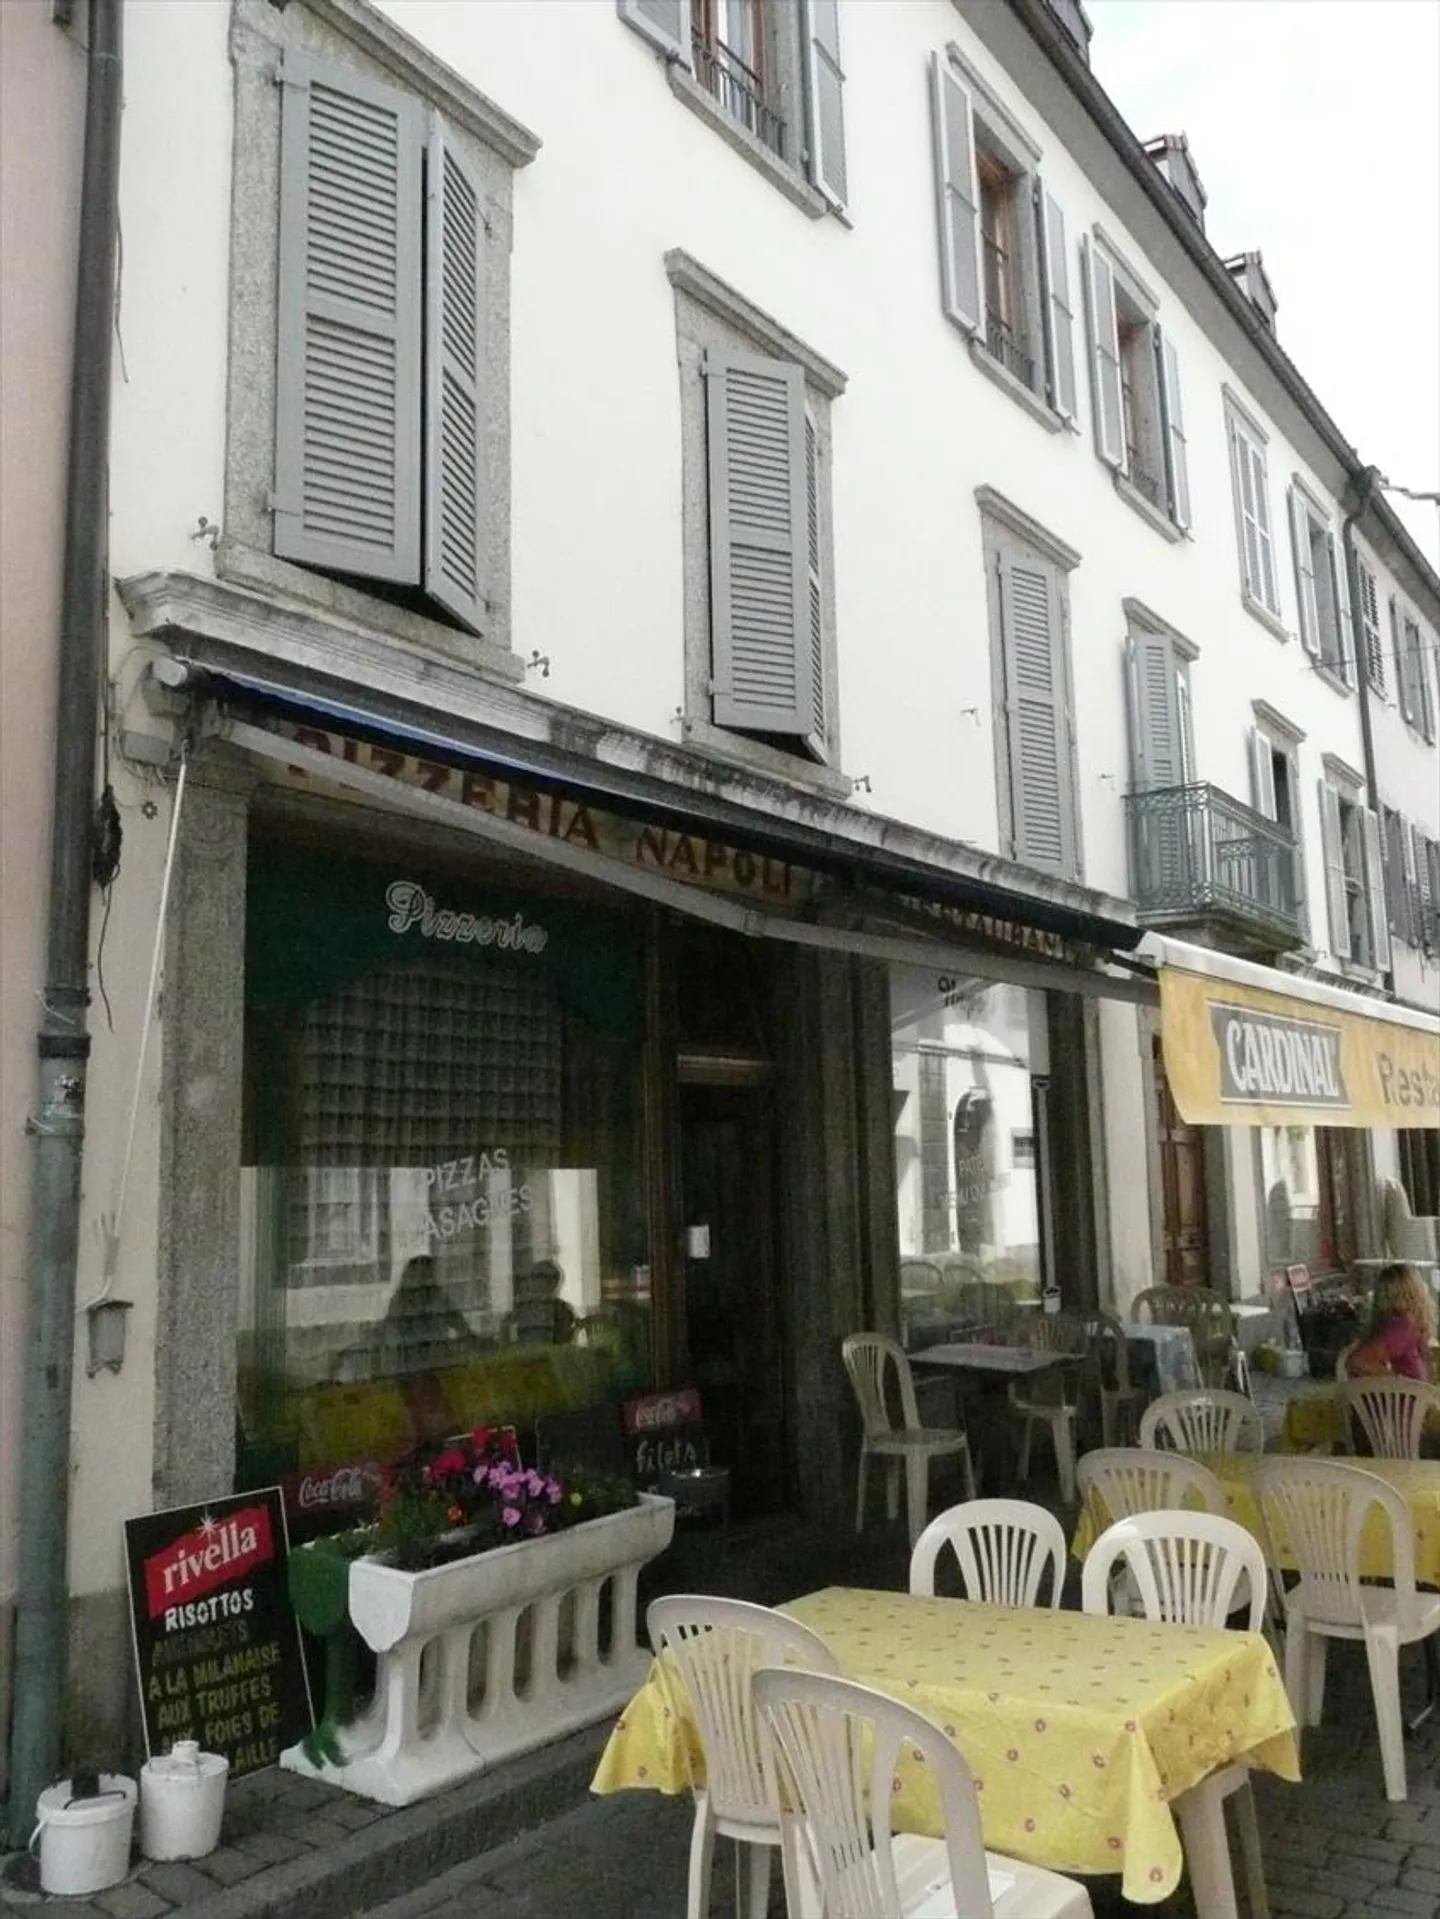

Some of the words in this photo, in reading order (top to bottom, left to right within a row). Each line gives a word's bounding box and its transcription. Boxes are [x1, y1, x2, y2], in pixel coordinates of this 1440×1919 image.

[635, 826, 791, 897] NAPOLI
[385, 880, 548, 954] Pizzeria
[1226, 1019, 1340, 1097] CARDINAL
[421, 1148, 510, 1193] PIZZAS
[418, 1184, 534, 1241] ASAGNES
[162, 1522, 258, 1595] rivella
[164, 1588, 254, 1633] RISOTTOS
[157, 1700, 193, 1731] AUX
[199, 1674, 271, 1717] TRUFFES
[165, 1667, 188, 1694] LA
[204, 1713, 254, 1747] FOIES
[259, 1702, 281, 1731] DE
